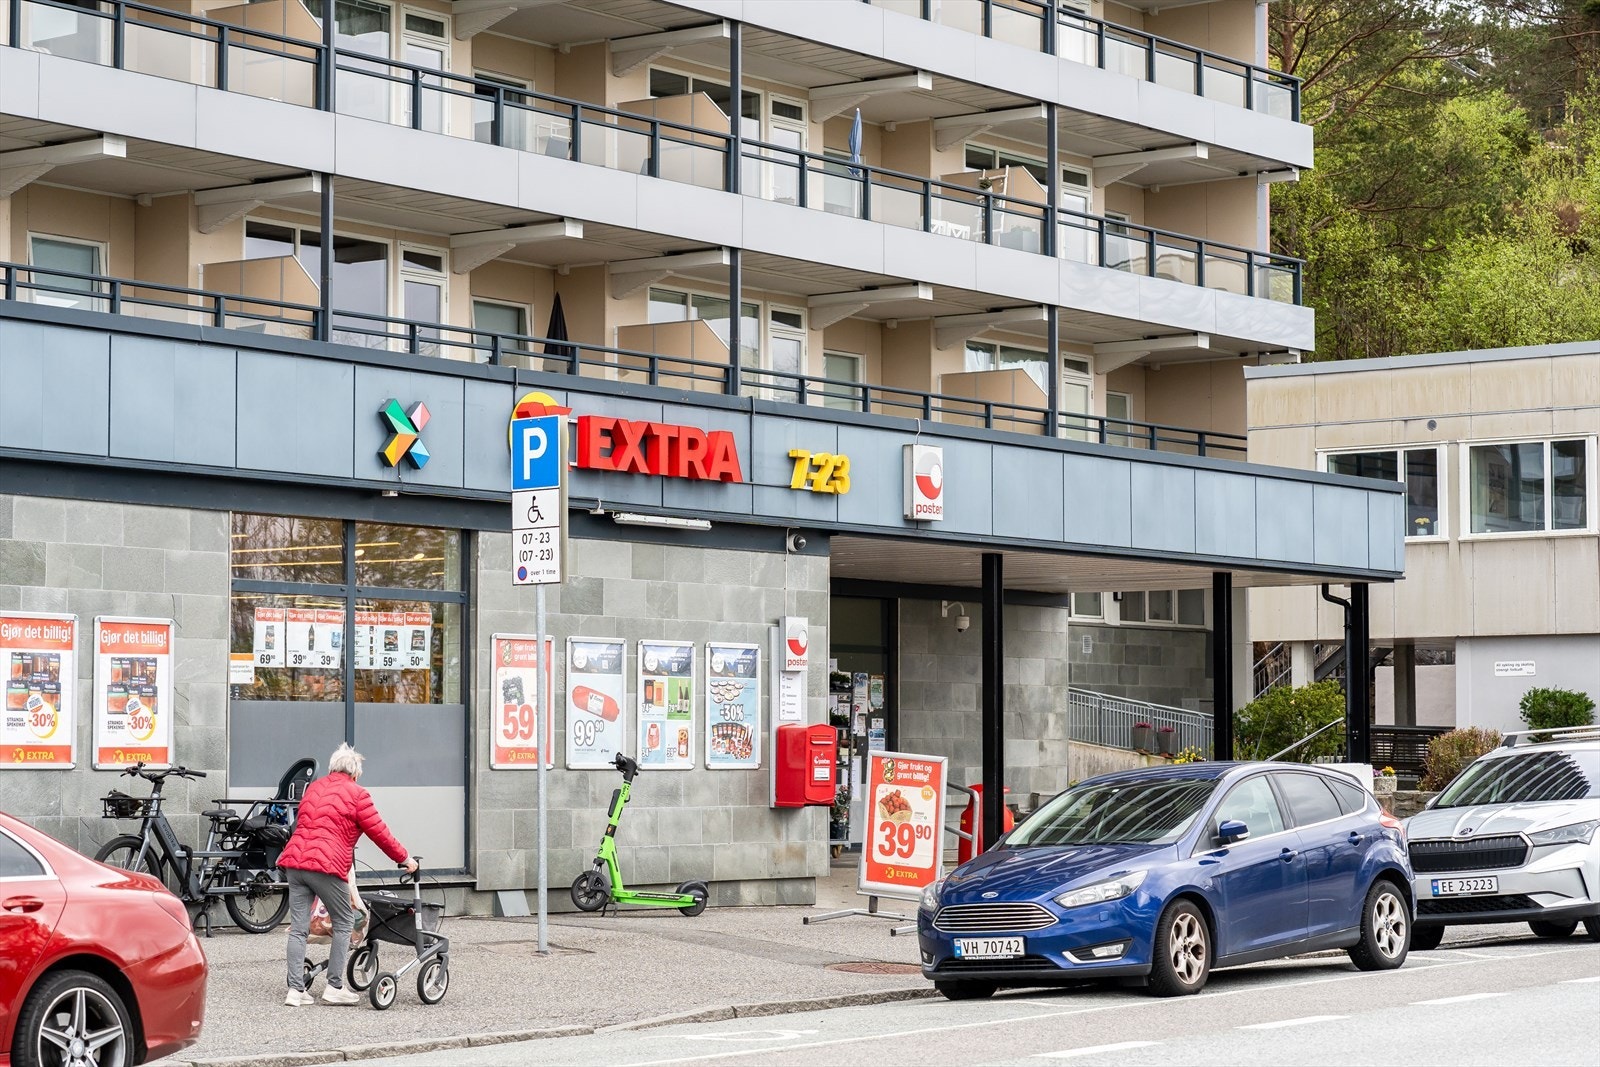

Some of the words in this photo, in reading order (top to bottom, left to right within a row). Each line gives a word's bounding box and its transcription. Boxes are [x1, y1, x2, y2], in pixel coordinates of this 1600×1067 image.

[523, 427, 548, 480] P
[578, 415, 743, 483] EXTRA
[788, 449, 850, 494] 7-23
[1, 624, 22, 640] Gjør
[24, 625, 42, 638] det
[44, 626, 71, 642] billig!
[101, 630, 121, 646] Gjør
[124, 631, 140, 644] det
[141, 631, 166, 647] billig!
[260, 654, 271, 664] 69
[292, 654, 302, 664] 39
[320, 656, 331, 665] 39
[384, 656, 392, 666] 59
[410, 656, 420, 666] 50
[720, 704, 744, 721] -30%
[28, 714, 56, 727] -30%
[128, 716, 153, 730] -30%
[503, 704, 534, 740] 59
[574, 720, 595, 746] 99
[26, 752, 54, 760] EXTRA
[126, 752, 152, 762] EXTRA
[516, 752, 536, 760] EXTRA
[898, 762, 909, 770] Gjør
[910, 763, 924, 771] frukt
[913, 774, 929, 782] billig!
[878, 821, 915, 858] 39
[916, 825, 932, 840] 90
[896, 870, 918, 878] EXTRA
[1442, 882, 1454, 892] EE
[1460, 879, 1493, 891] 25223
[963, 942, 978, 954] VH
[984, 940, 1020, 953] 70742
